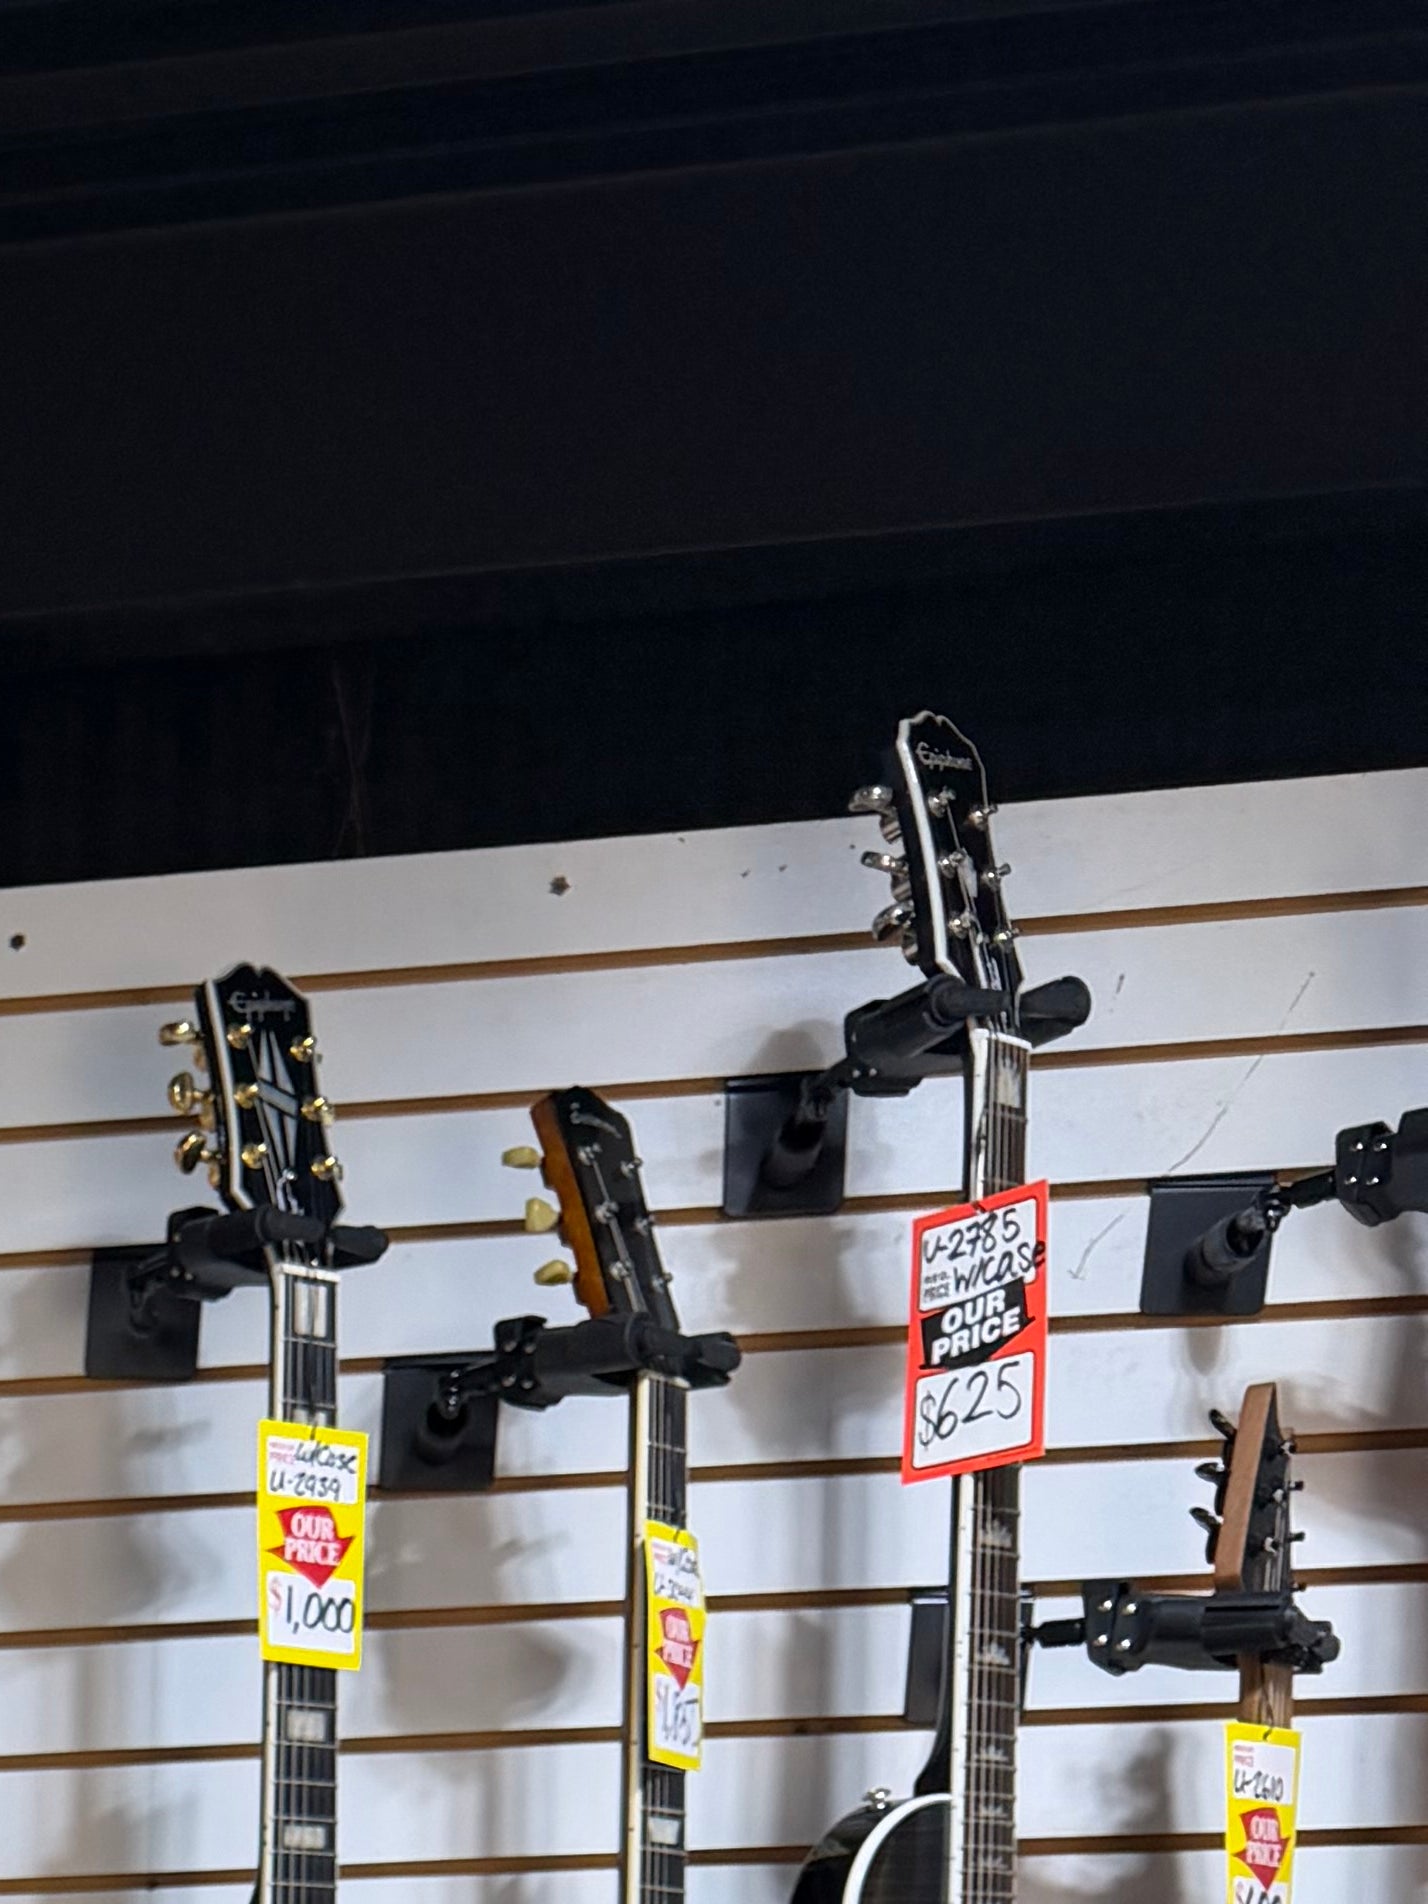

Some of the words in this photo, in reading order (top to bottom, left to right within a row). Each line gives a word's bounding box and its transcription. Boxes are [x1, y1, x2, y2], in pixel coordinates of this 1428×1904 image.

[941, 1288, 1005, 1334] OUR
[931, 1307, 1021, 1365] PRICE
[919, 1361, 1021, 1450] $625
[290, 1511, 335, 1541] OUR
[285, 1538, 341, 1567] PRICE
[1250, 1815, 1279, 1840] OUR
[1246, 1840, 1283, 1868] PRICE
